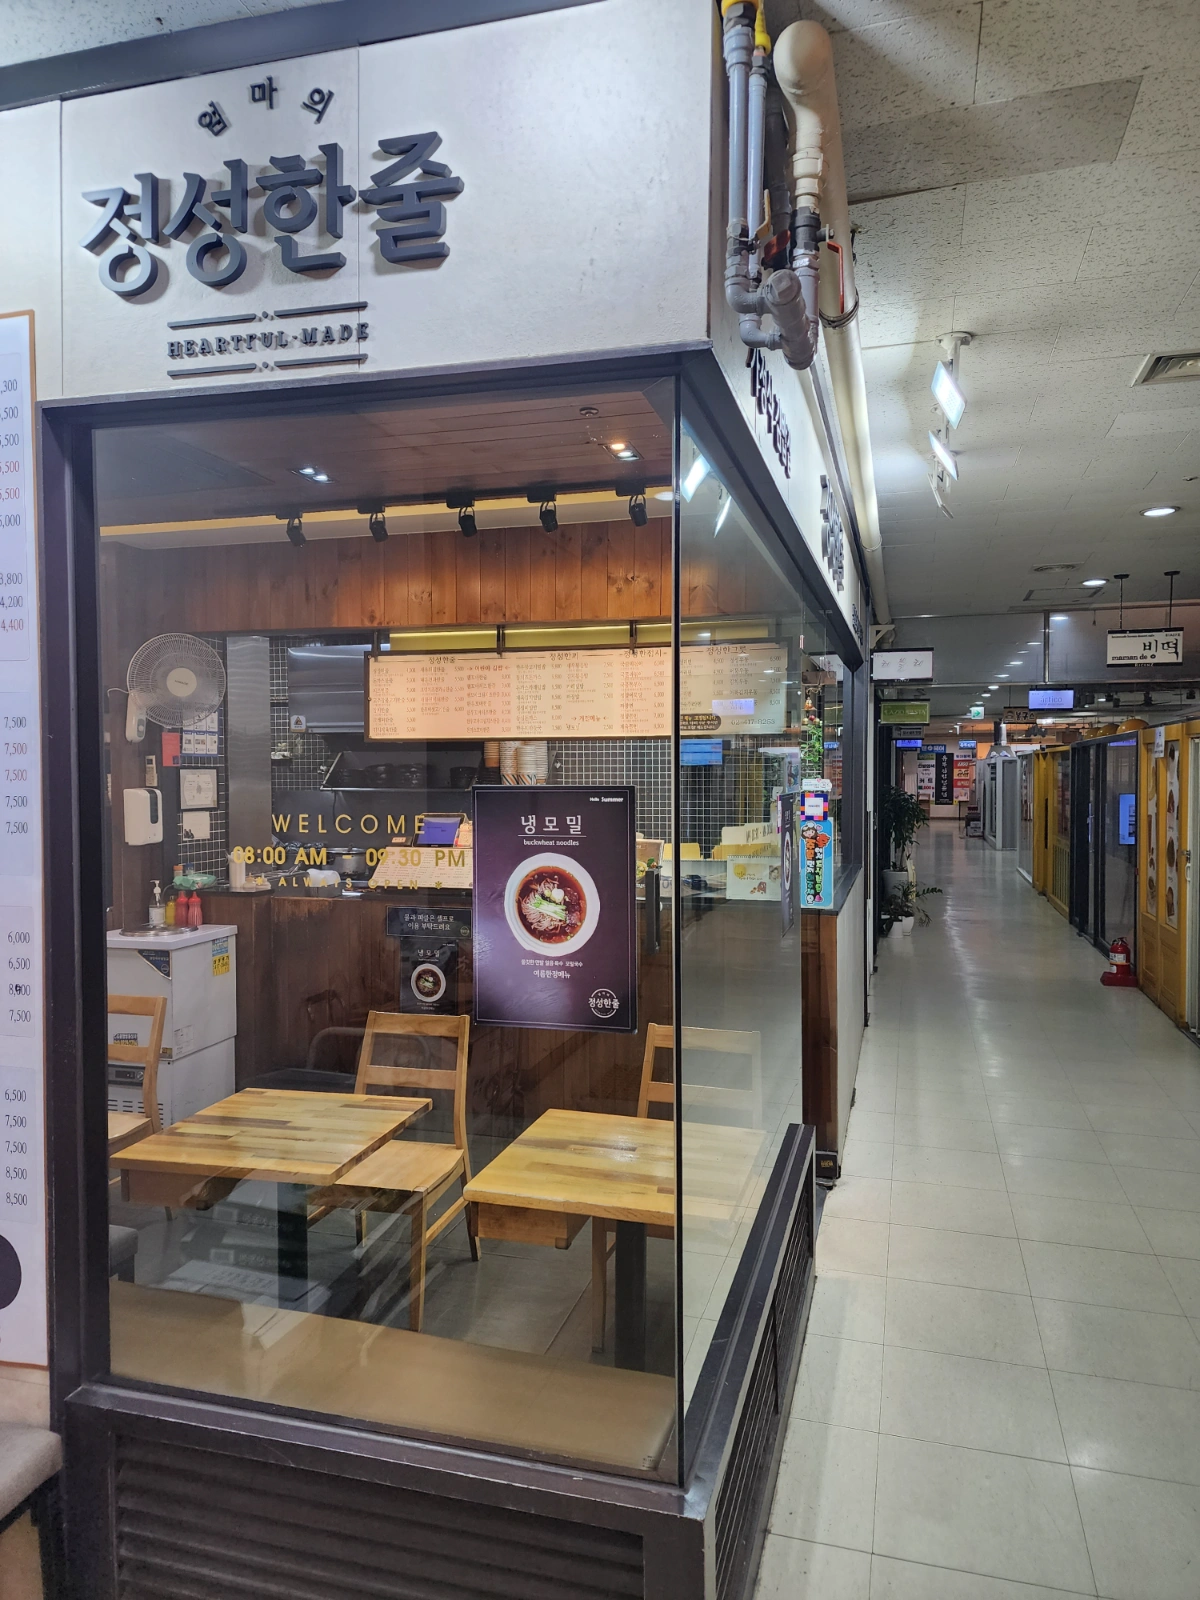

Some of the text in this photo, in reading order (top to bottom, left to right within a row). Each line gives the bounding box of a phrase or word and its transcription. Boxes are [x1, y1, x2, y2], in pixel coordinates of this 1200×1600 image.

[197, 76, 334, 137] 엄마의
[79, 130, 465, 296] 정성한줄
[0, 406, 19, 421] ,500
[0, 572, 23, 587] 3,800
[0, 595, 24, 610] 4,200
[1, 618, 24, 633] 4,400
[3, 716, 27, 730] 7,500
[4, 742, 28, 756] 7,500
[5, 769, 28, 782] 7,500
[5, 795, 28, 809] 7,500
[6, 821, 29, 835] 7,500
[272, 813, 426, 834] WELCOME
[520, 814, 582, 835] 냉모밀
[232, 846, 286, 865] 08:00
[294, 848, 327, 866] AM
[365, 848, 422, 867] 09:30
[435, 849, 466, 868] PM
[278, 877, 419, 890] ALWAYS OPEN
[7, 931, 31, 945] 6,000
[8, 957, 31, 971] 6,500
[588, 998, 620, 1009] 정성한줄
[9, 1009, 32, 1023] 7,500
[5, 1089, 27, 1104] 6,500
[5, 1115, 27, 1130] 7,500
[5, 1141, 27, 1156] 7,500
[6, 1167, 28, 1182] 8,500
[6, 1193, 28, 1208] 8,500
